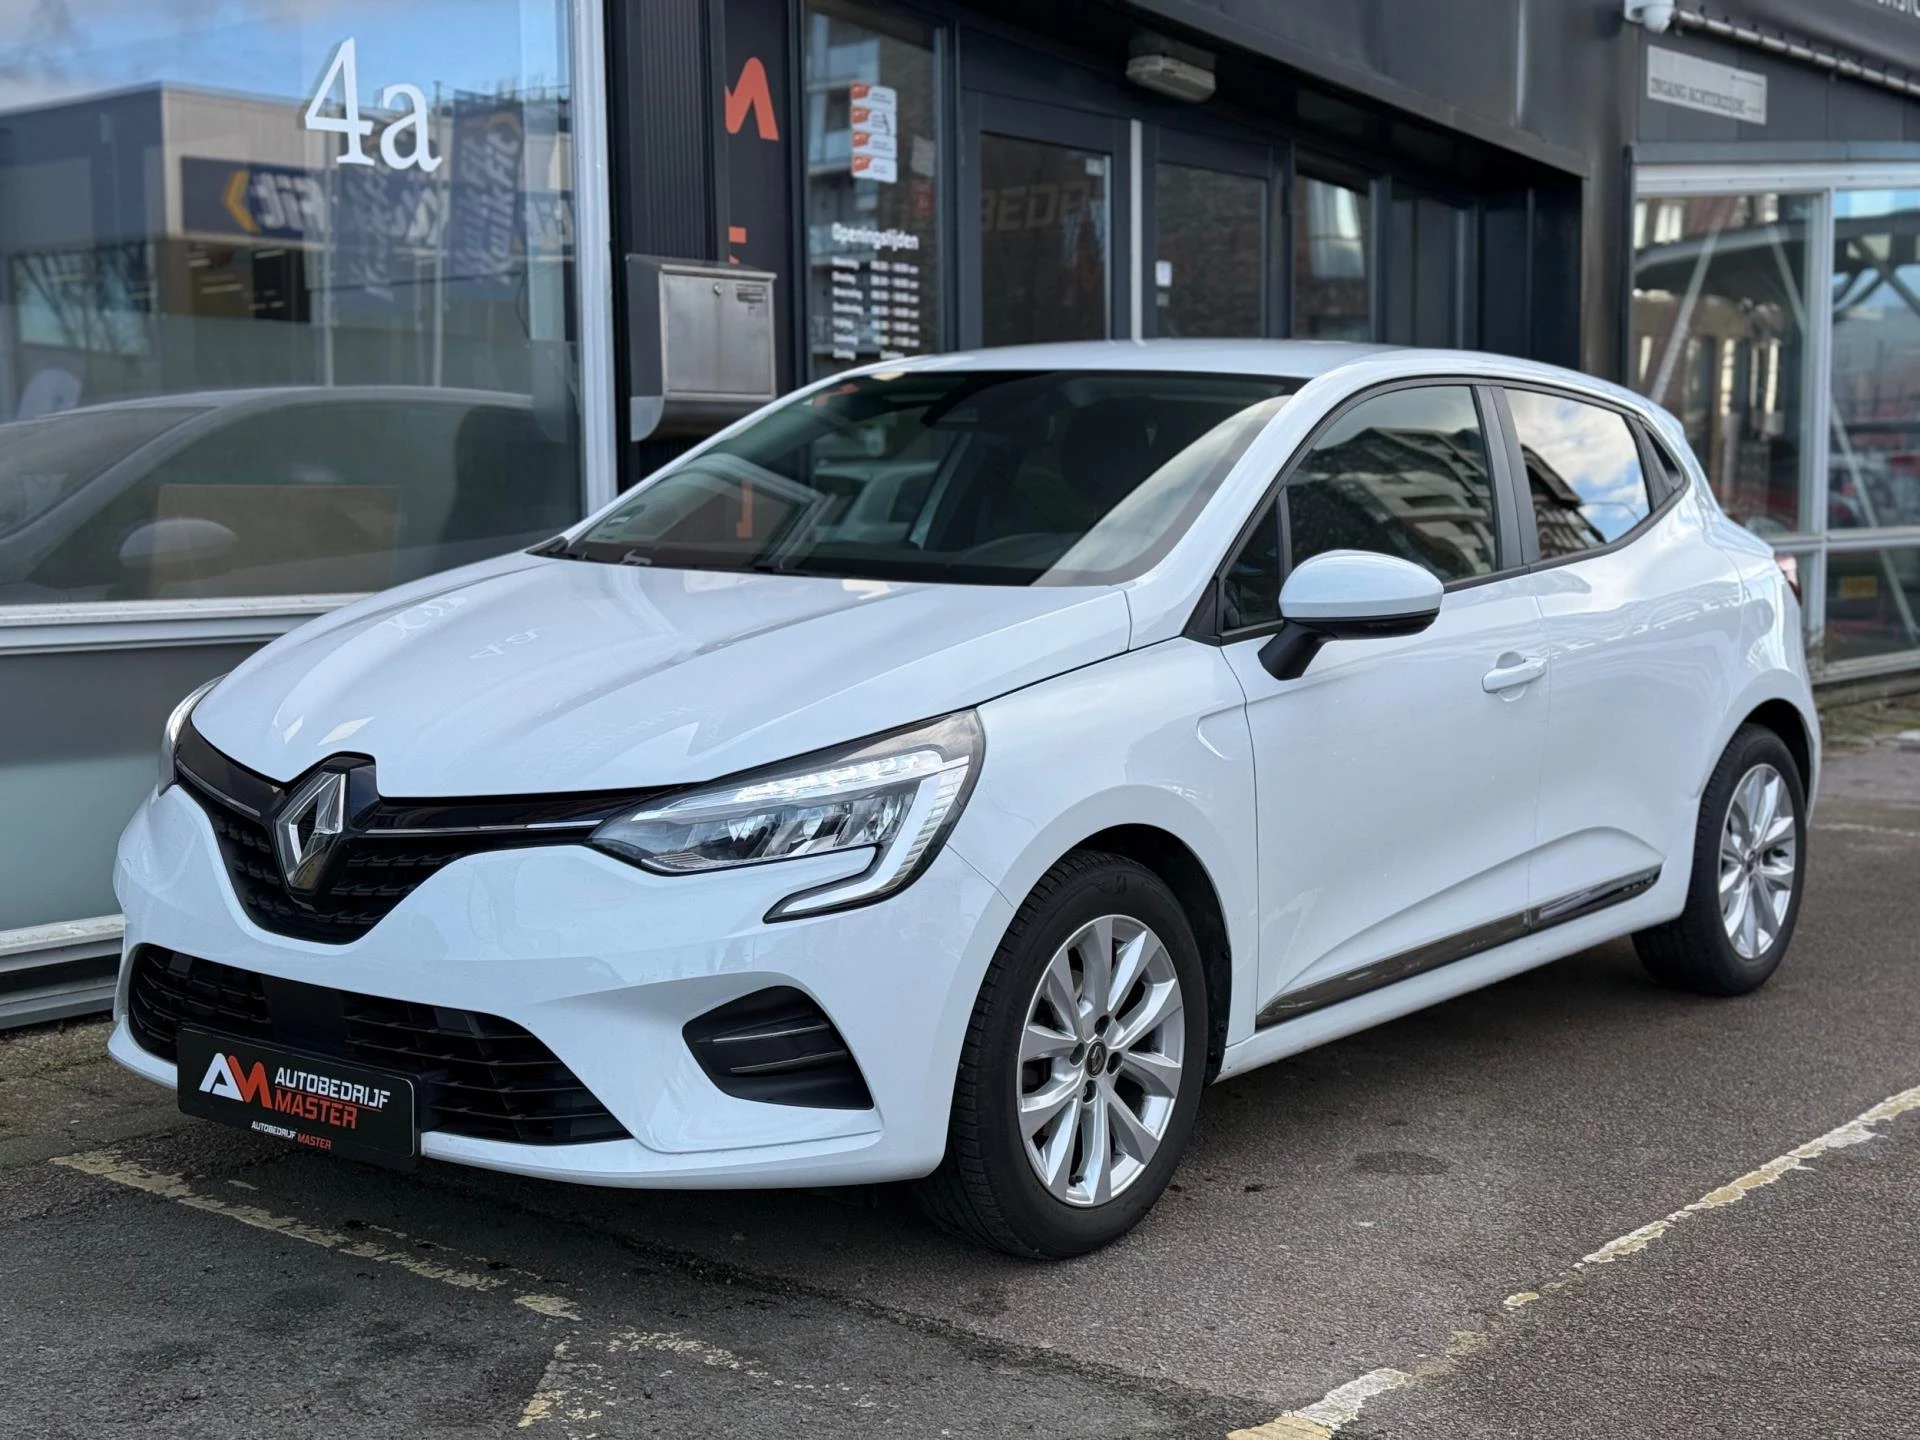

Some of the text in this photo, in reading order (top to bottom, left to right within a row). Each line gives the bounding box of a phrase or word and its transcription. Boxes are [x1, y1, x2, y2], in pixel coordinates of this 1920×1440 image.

[305, 37, 443, 172] 4a
[275, 1067, 391, 1109] AUTOBEDRIJF
[275, 1089, 359, 1129] MASTER
[251, 1120, 332, 1150] AUTOBEDRIJF MASTER
